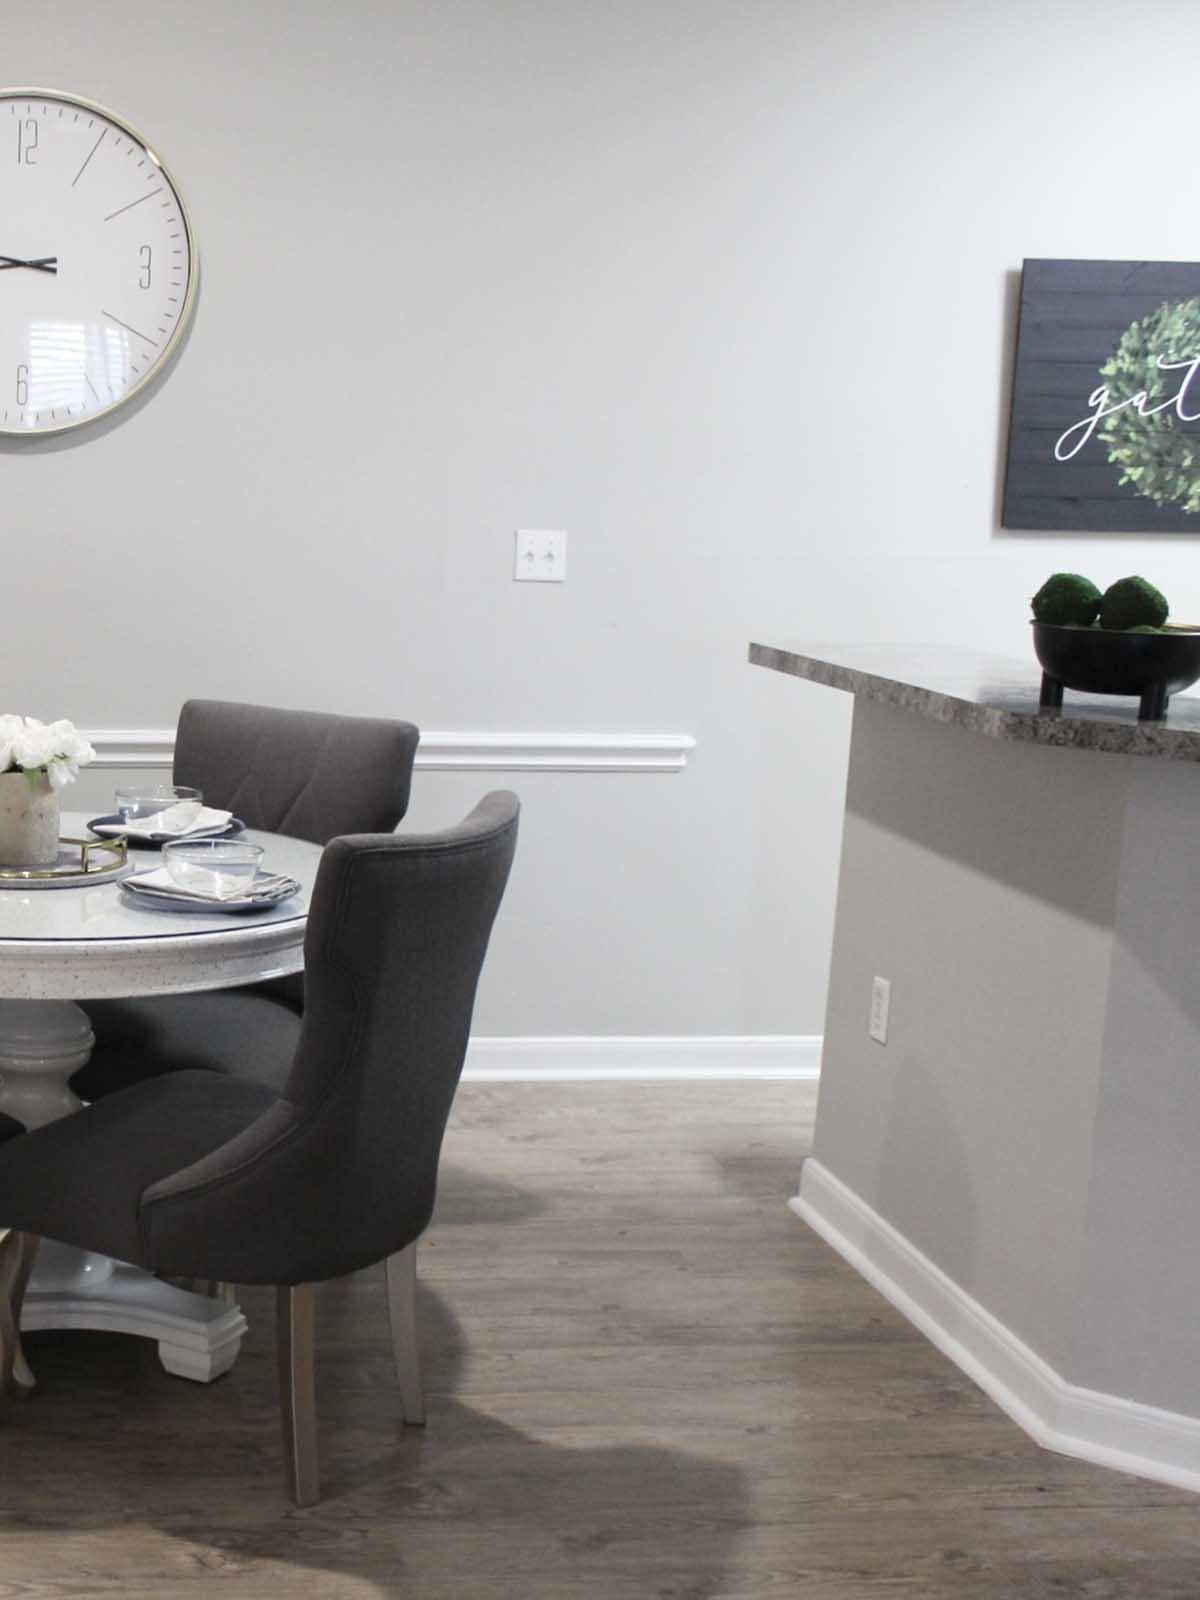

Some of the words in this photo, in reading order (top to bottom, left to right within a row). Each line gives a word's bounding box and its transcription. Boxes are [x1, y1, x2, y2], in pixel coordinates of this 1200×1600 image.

[17, 119, 39, 164] 12
[139, 245, 152, 289] 3
[16, 364, 28, 406] 6
